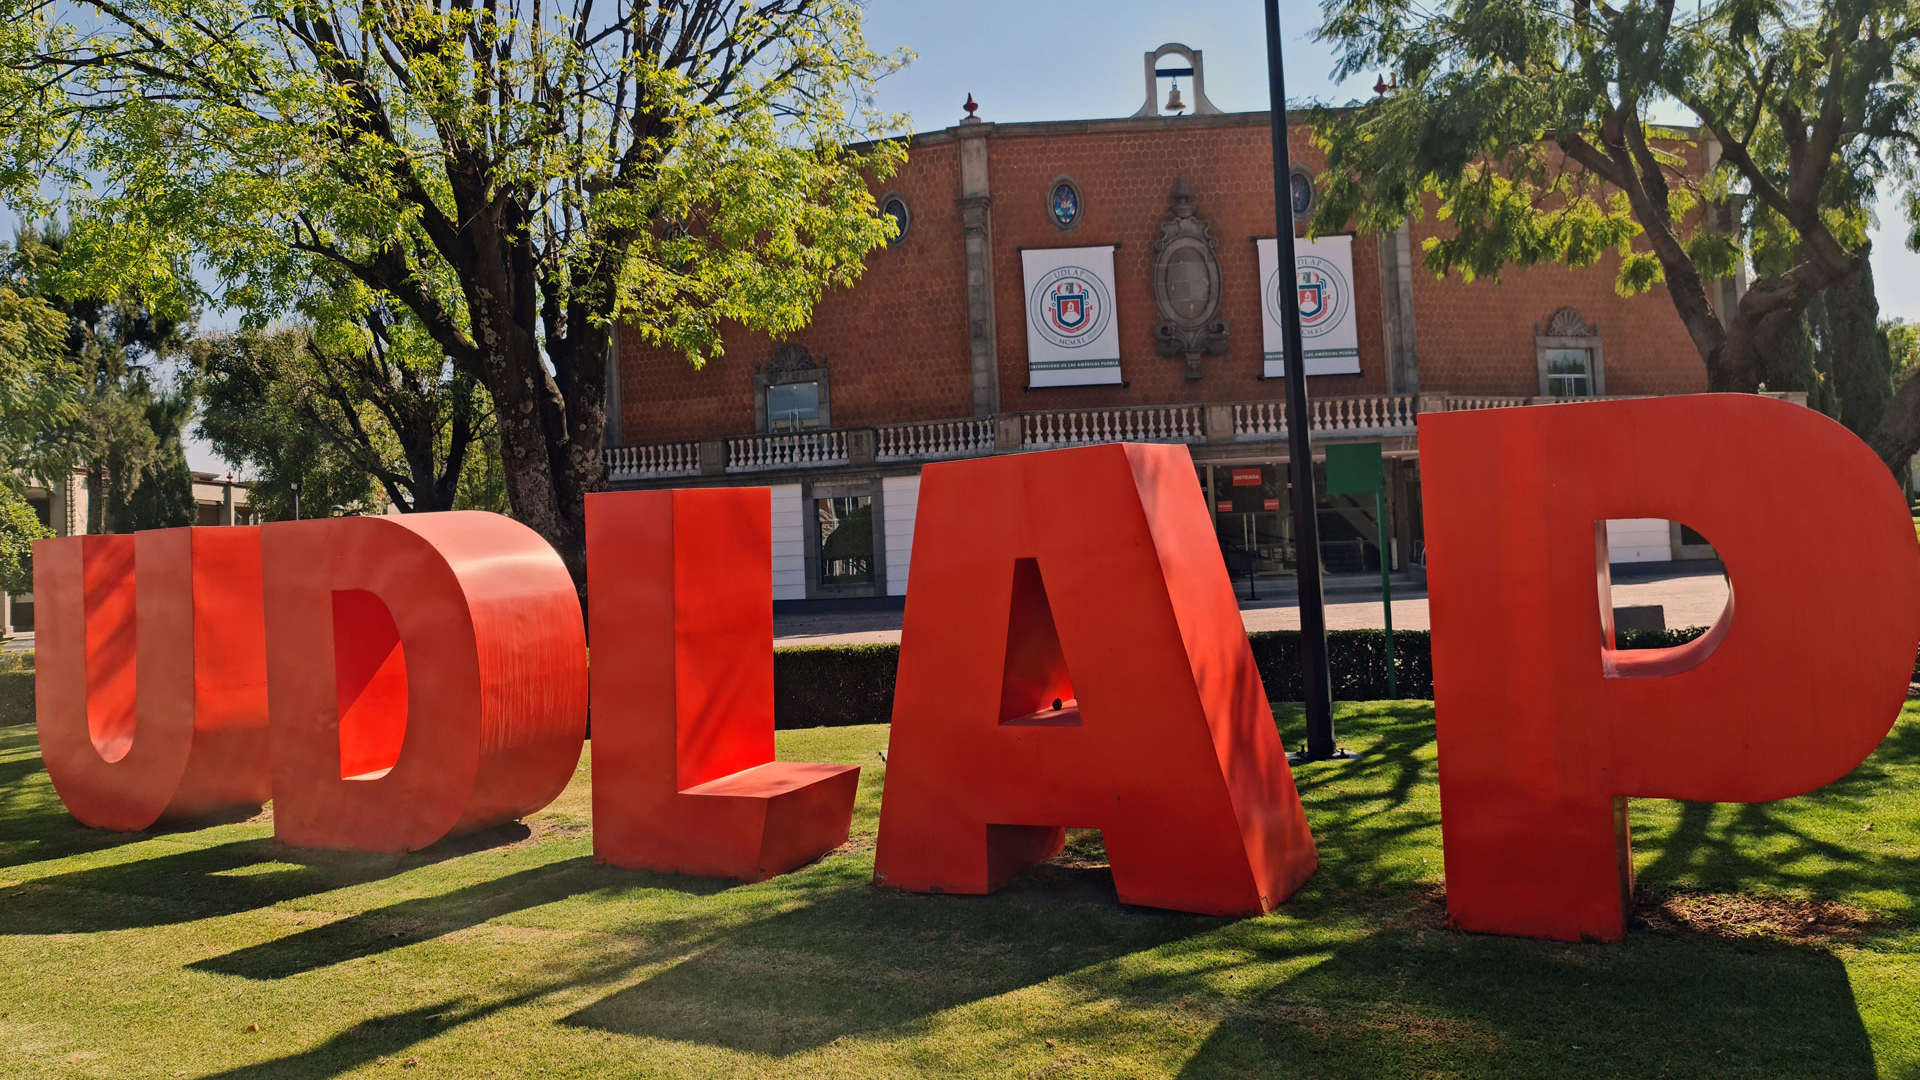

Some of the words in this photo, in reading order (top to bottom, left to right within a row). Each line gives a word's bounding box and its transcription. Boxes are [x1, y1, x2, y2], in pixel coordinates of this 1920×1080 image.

[1296, 257, 1322, 266] DLAP
[1053, 268, 1085, 278] UDLAP
[1301, 327, 1324, 335] CMXL
[1059, 337, 1086, 345] MCMXL
[33, 392, 1919, 942] UDLAP
